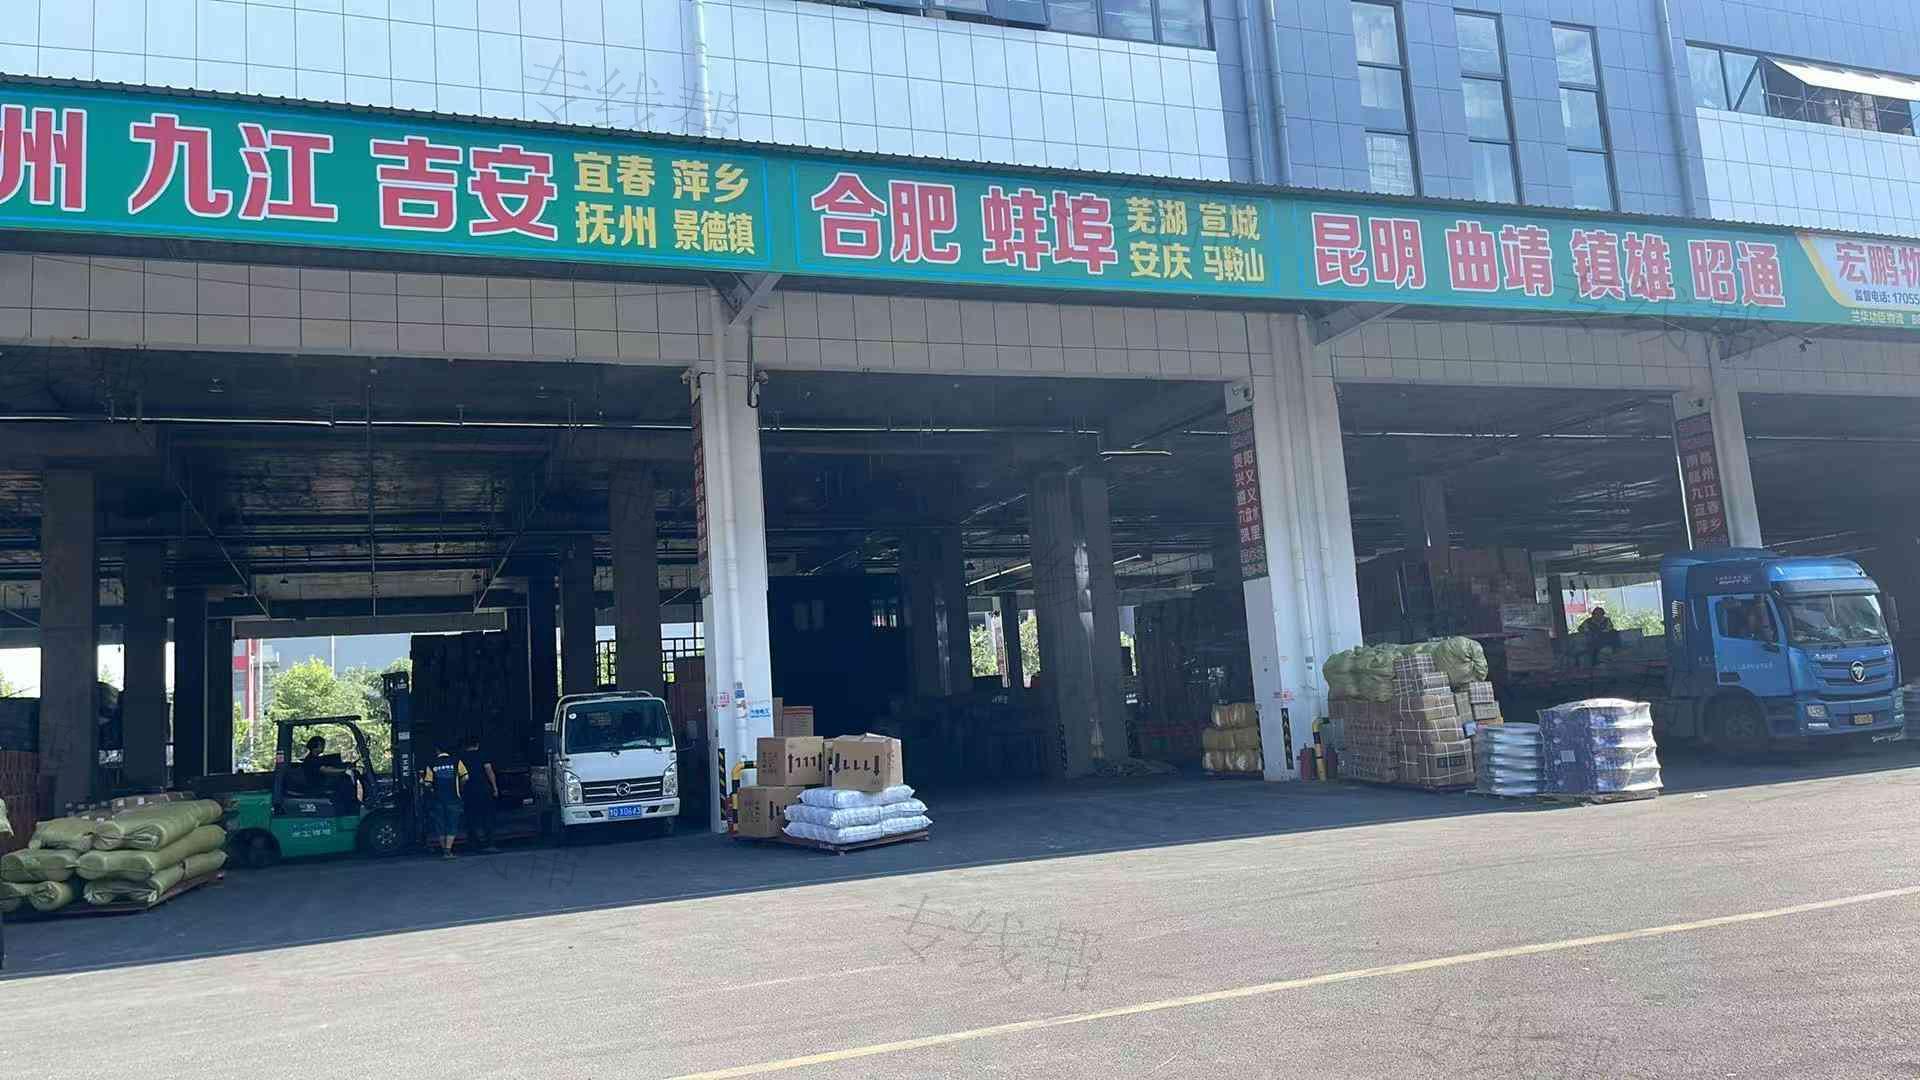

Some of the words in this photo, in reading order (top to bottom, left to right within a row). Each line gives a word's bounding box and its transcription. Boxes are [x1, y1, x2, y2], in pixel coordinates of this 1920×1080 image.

[0, 103, 87, 212] 州
[128, 112, 339, 223] 九江
[370, 135, 559, 241] 吉安
[573, 151, 655, 197] 宜春
[672, 160, 749, 203] 萍乡
[575, 201, 657, 249] 抚州
[674, 208, 756, 255] 景德镇
[811, 172, 961, 265] 合肥
[981, 185, 1118, 275] 蚌埠
[1125, 196, 1188, 235] 芜湖
[1200, 202, 1261, 240] 宣城
[1129, 241, 1193, 280] 安庆
[1203, 245, 1265, 283] 马鞍山
[1311, 212, 1426, 289] 昆明
[1445, 221, 1554, 297] 曲靖
[1570, 228, 1677, 303] 镇雄
[1687, 239, 1786, 308] 昭通
